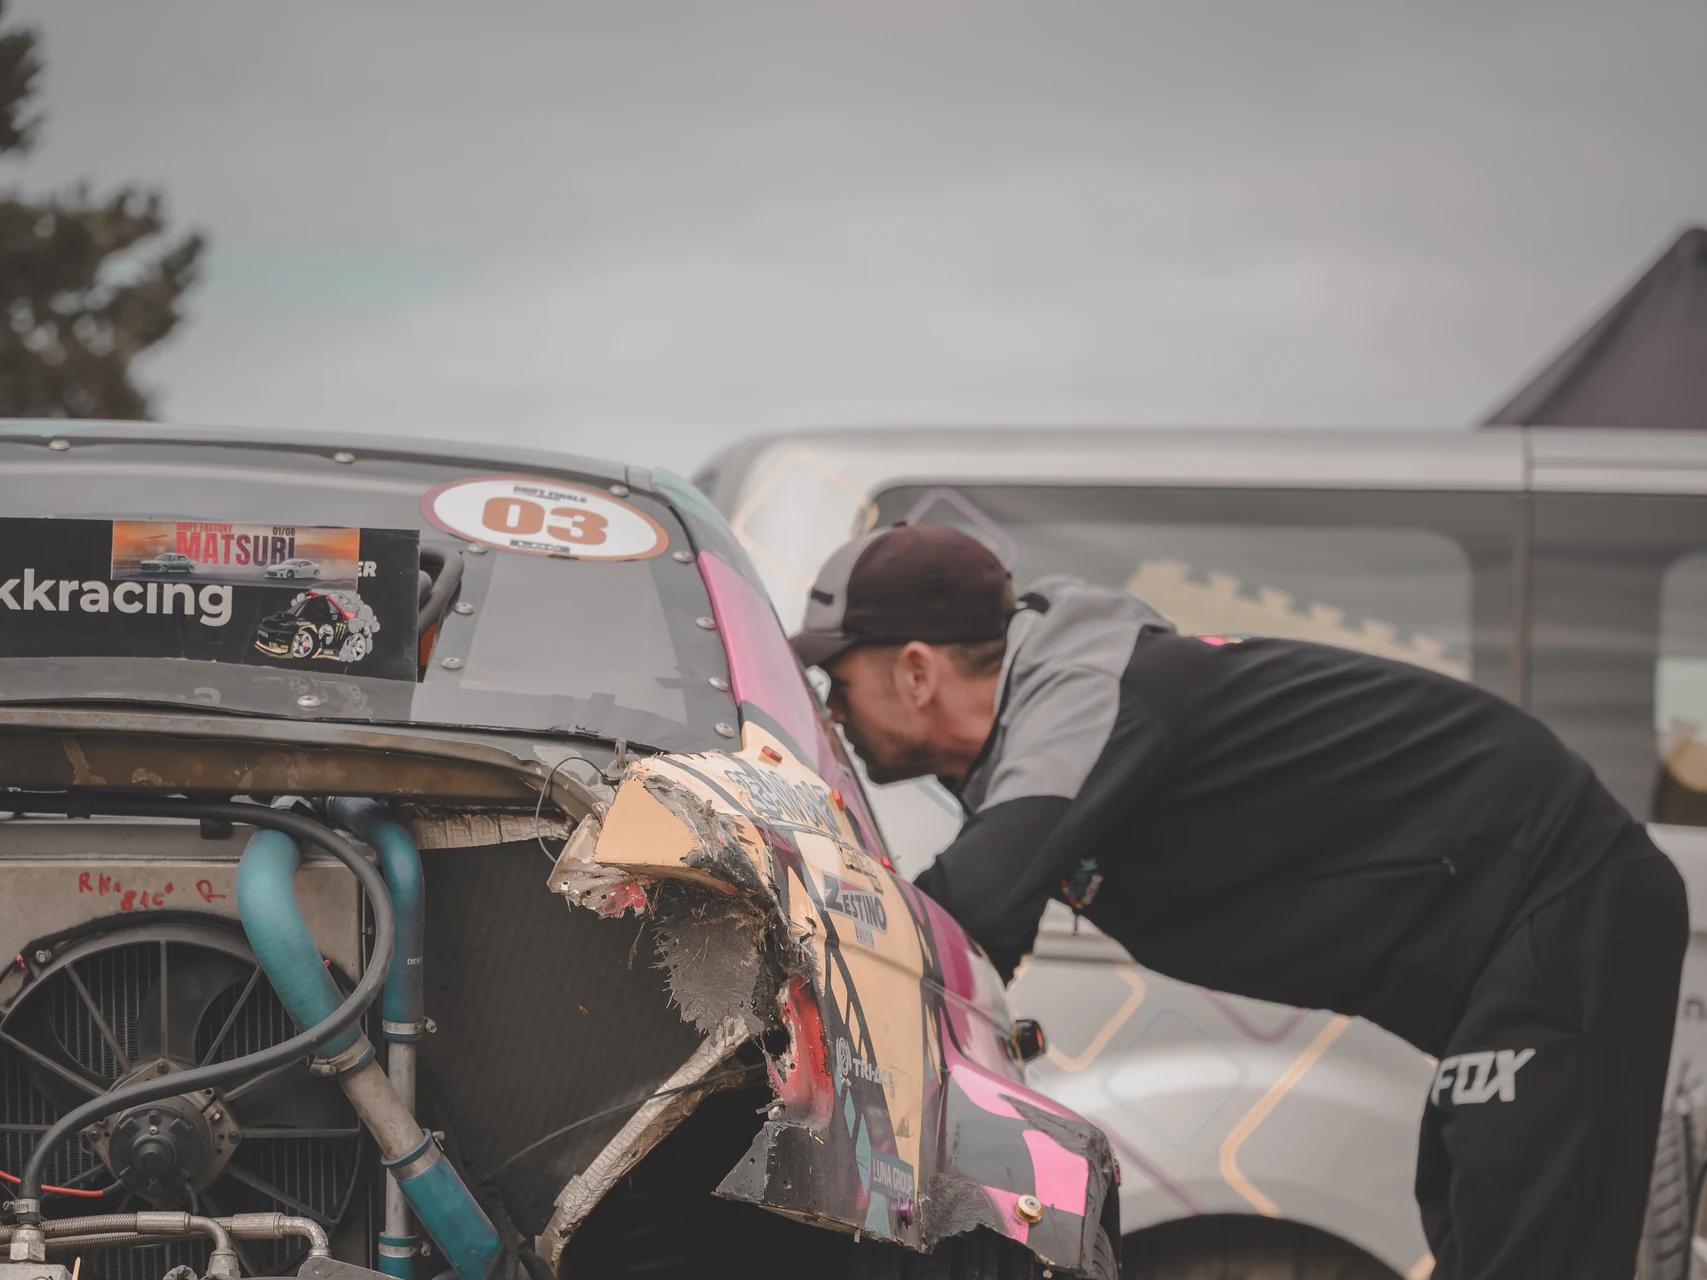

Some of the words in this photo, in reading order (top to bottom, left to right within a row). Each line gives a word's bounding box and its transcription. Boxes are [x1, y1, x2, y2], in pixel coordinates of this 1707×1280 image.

[176, 522, 199, 532] DRIFT
[200, 523, 233, 533] FACTORY
[272, 527, 296, 536] 01/08
[482, 496, 609, 545] 03
[175, 532, 296, 567] MATSURI
[824, 873, 887, 930] ZESTINO
[1431, 1048, 1536, 1106] FOX
[872, 1158, 892, 1188] LUNA
[893, 1166, 913, 1194] GROUP
